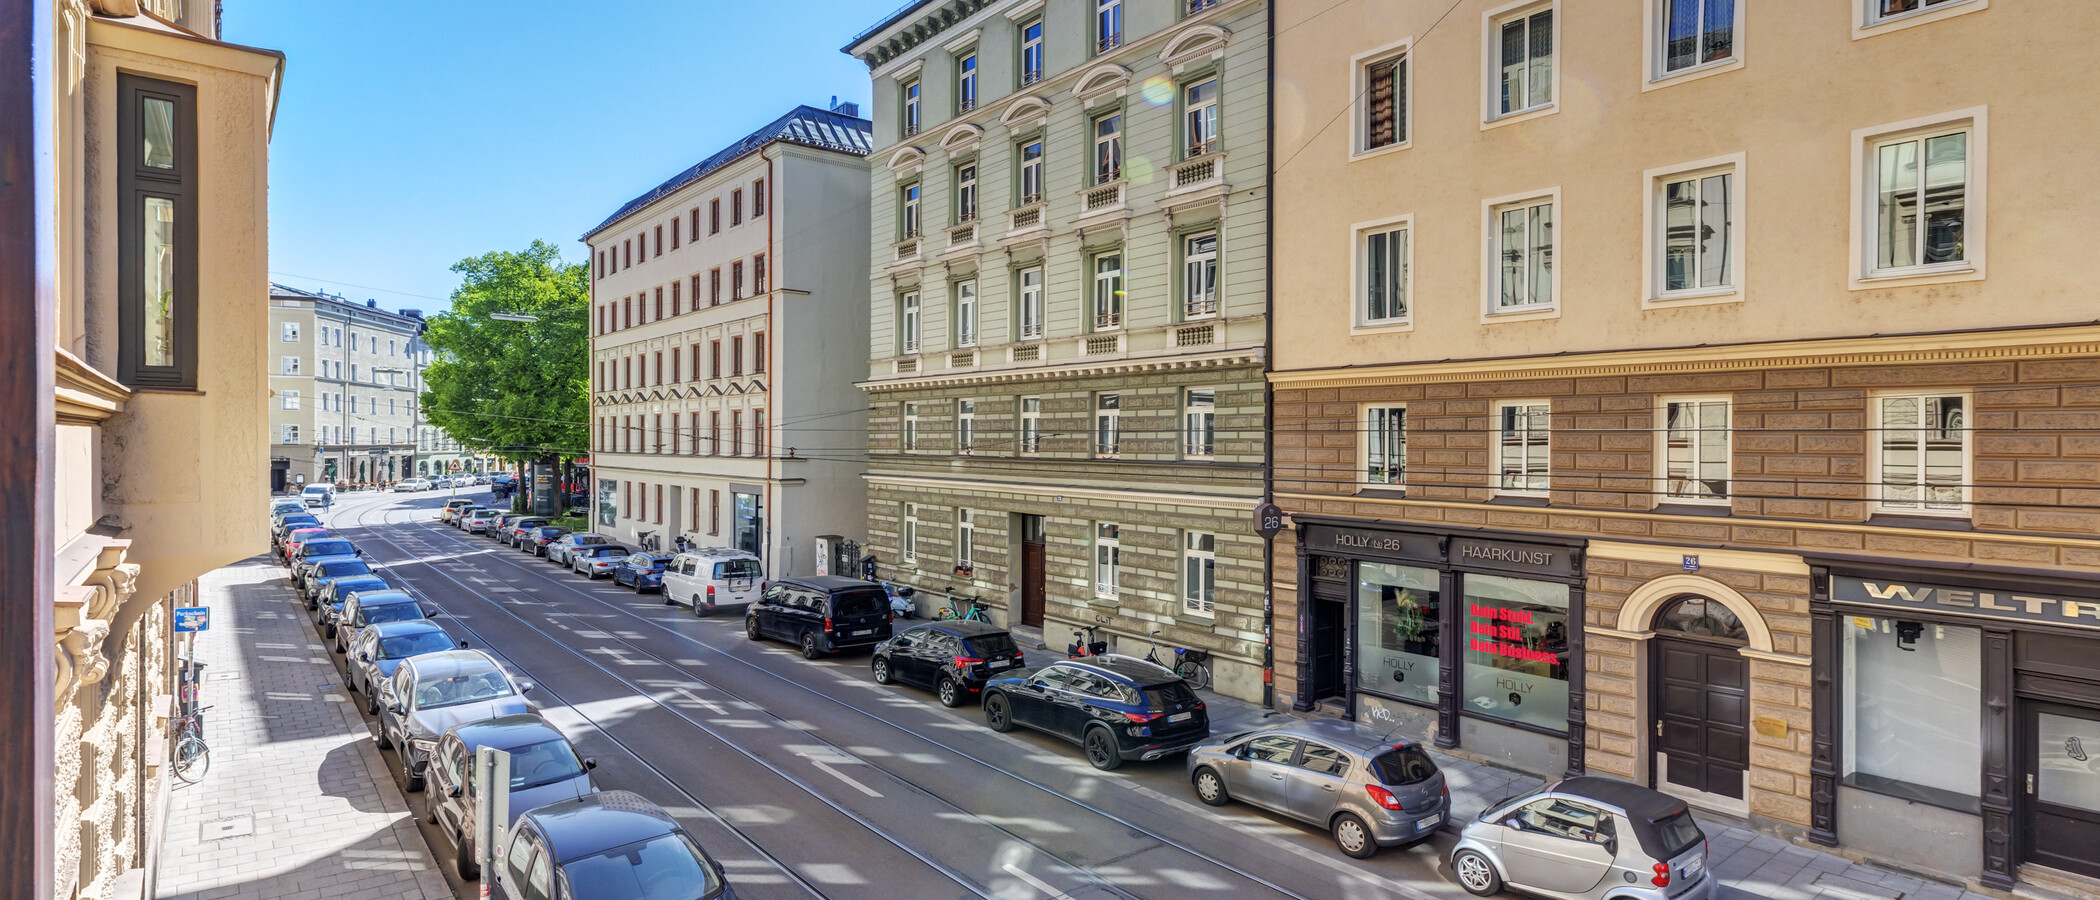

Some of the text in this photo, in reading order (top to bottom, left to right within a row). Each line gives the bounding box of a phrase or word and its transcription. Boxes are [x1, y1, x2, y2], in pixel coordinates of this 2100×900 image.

[1264, 516, 1279, 529] 26
[1335, 534, 1370, 547] HOLLY
[1462, 545, 1552, 565] HAARKUNST
[1685, 556, 1697, 565] 26
[1862, 582, 2100, 620] WELTR
[1470, 603, 1534, 625] Dein Stuhl.
[1470, 621, 1523, 641] Dein Stil.
[1470, 638, 1560, 666] Dein Business.
[1383, 656, 1415, 671] HOLLY
[1496, 677, 1534, 693] HOLLY
